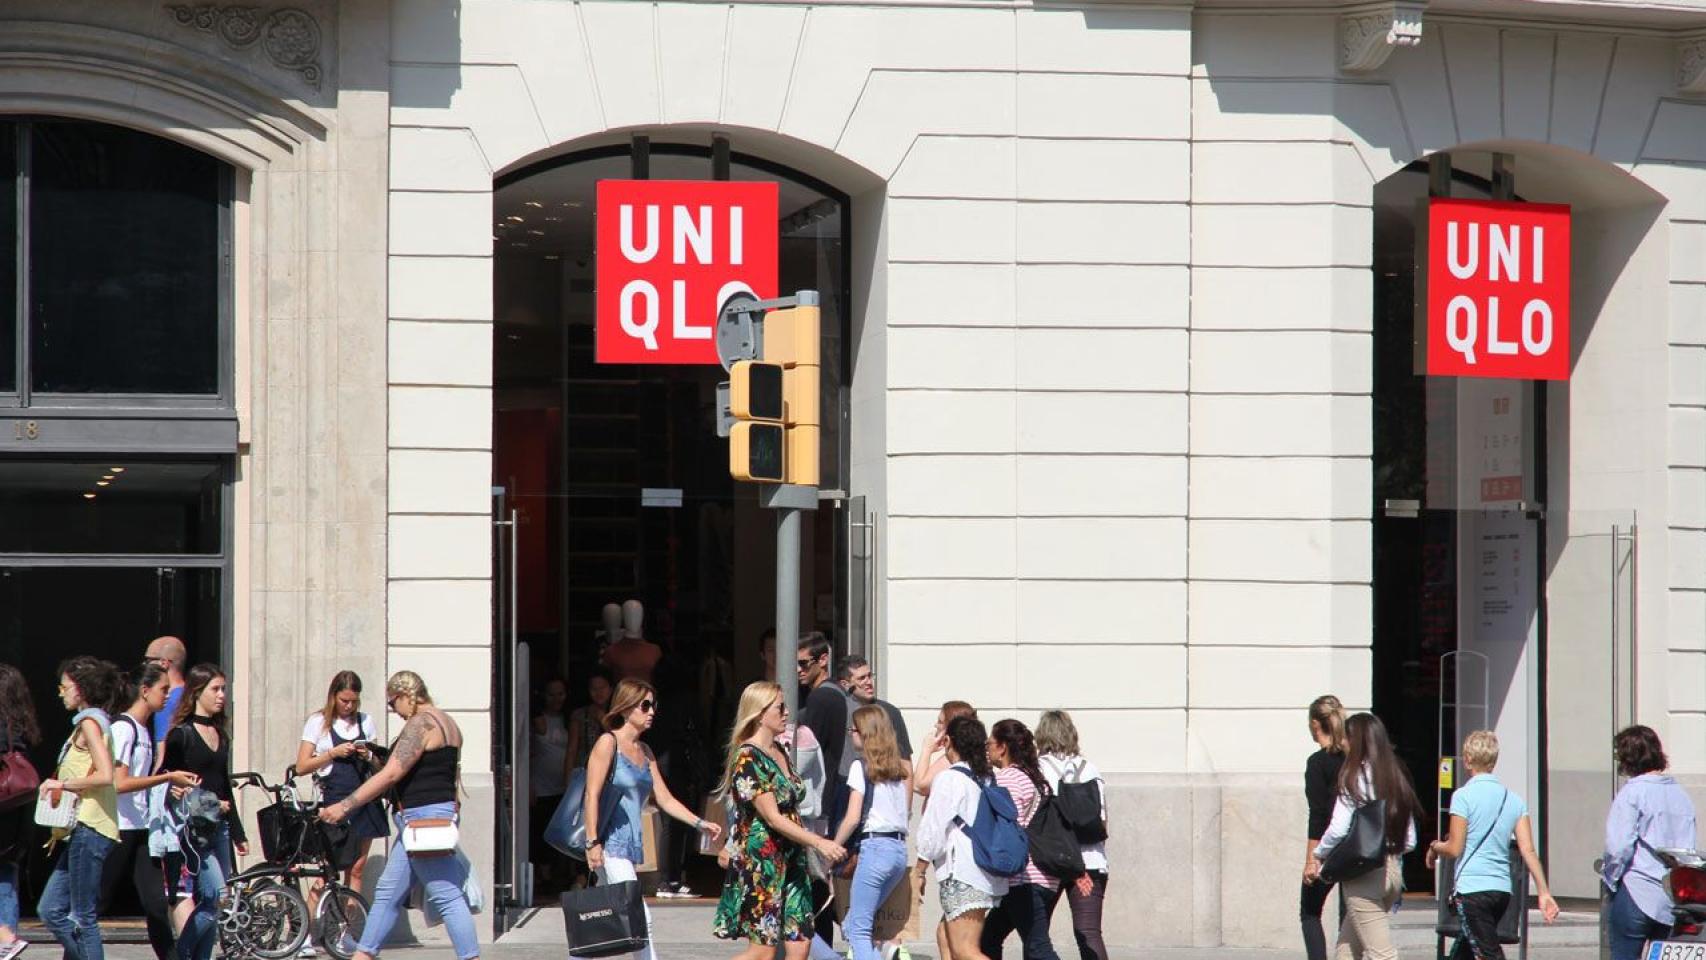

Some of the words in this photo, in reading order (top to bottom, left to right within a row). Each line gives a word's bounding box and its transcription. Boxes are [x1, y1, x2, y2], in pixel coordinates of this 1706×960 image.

[620, 204, 743, 265] UNI
[1447, 221, 1544, 284] UNI
[1445, 294, 1553, 364] QLO
[14, 420, 38, 438] 18
[1662, 944, 1705, 960] 8378
